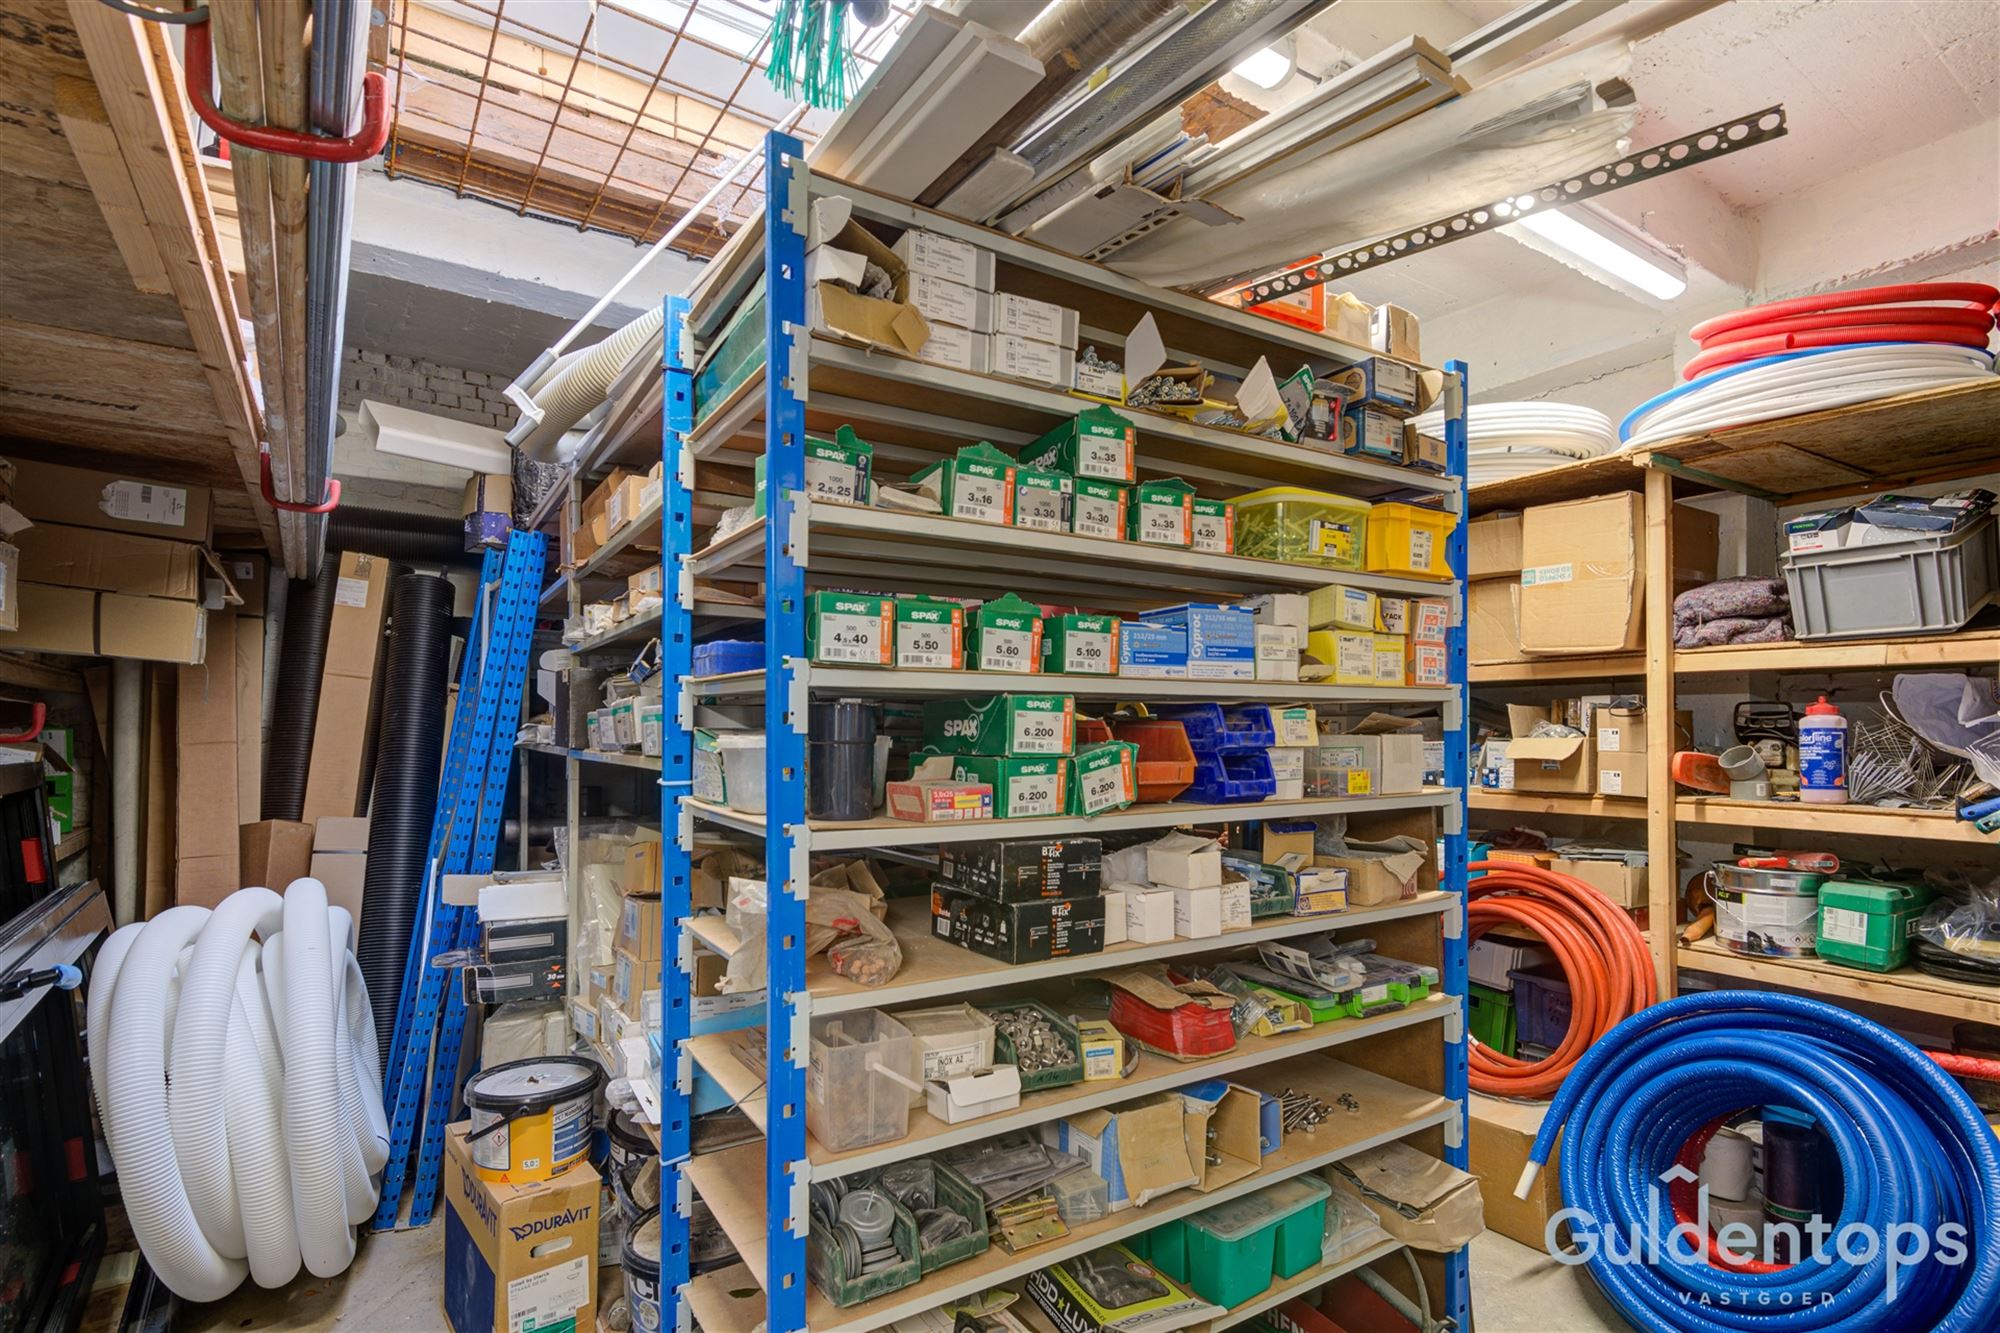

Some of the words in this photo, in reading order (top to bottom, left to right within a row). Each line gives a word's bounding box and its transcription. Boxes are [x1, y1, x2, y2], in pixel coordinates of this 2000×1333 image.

[1091, 426, 1116, 438] SPAX
[816, 448, 847, 462] SPAX
[1029, 446, 1059, 472] PAX
[969, 464, 996, 478] SPAX
[1027, 477, 1054, 488] SPAX
[1087, 486, 1110, 498] SPAX
[1151, 493, 1175, 505] SPAX
[1194, 504, 1217, 515] SPAX
[835, 601, 867, 615] SPAX
[911, 610, 940, 622] SPAX
[995, 617, 1022, 630] SPAX
[1077, 620, 1102, 632] SPAX
[1191, 614, 1204, 658] Gyproc
[1120, 630, 1131, 664] Gyproc
[1026, 699, 1053, 710] SPAX
[943, 717, 979, 738] SPAX
[1021, 763, 1047, 774] SPAX
[1088, 756, 1111, 769] SPAX
[470, 1183, 497, 1238] DURAVIT
[534, 1207, 592, 1234] DURAVIT
